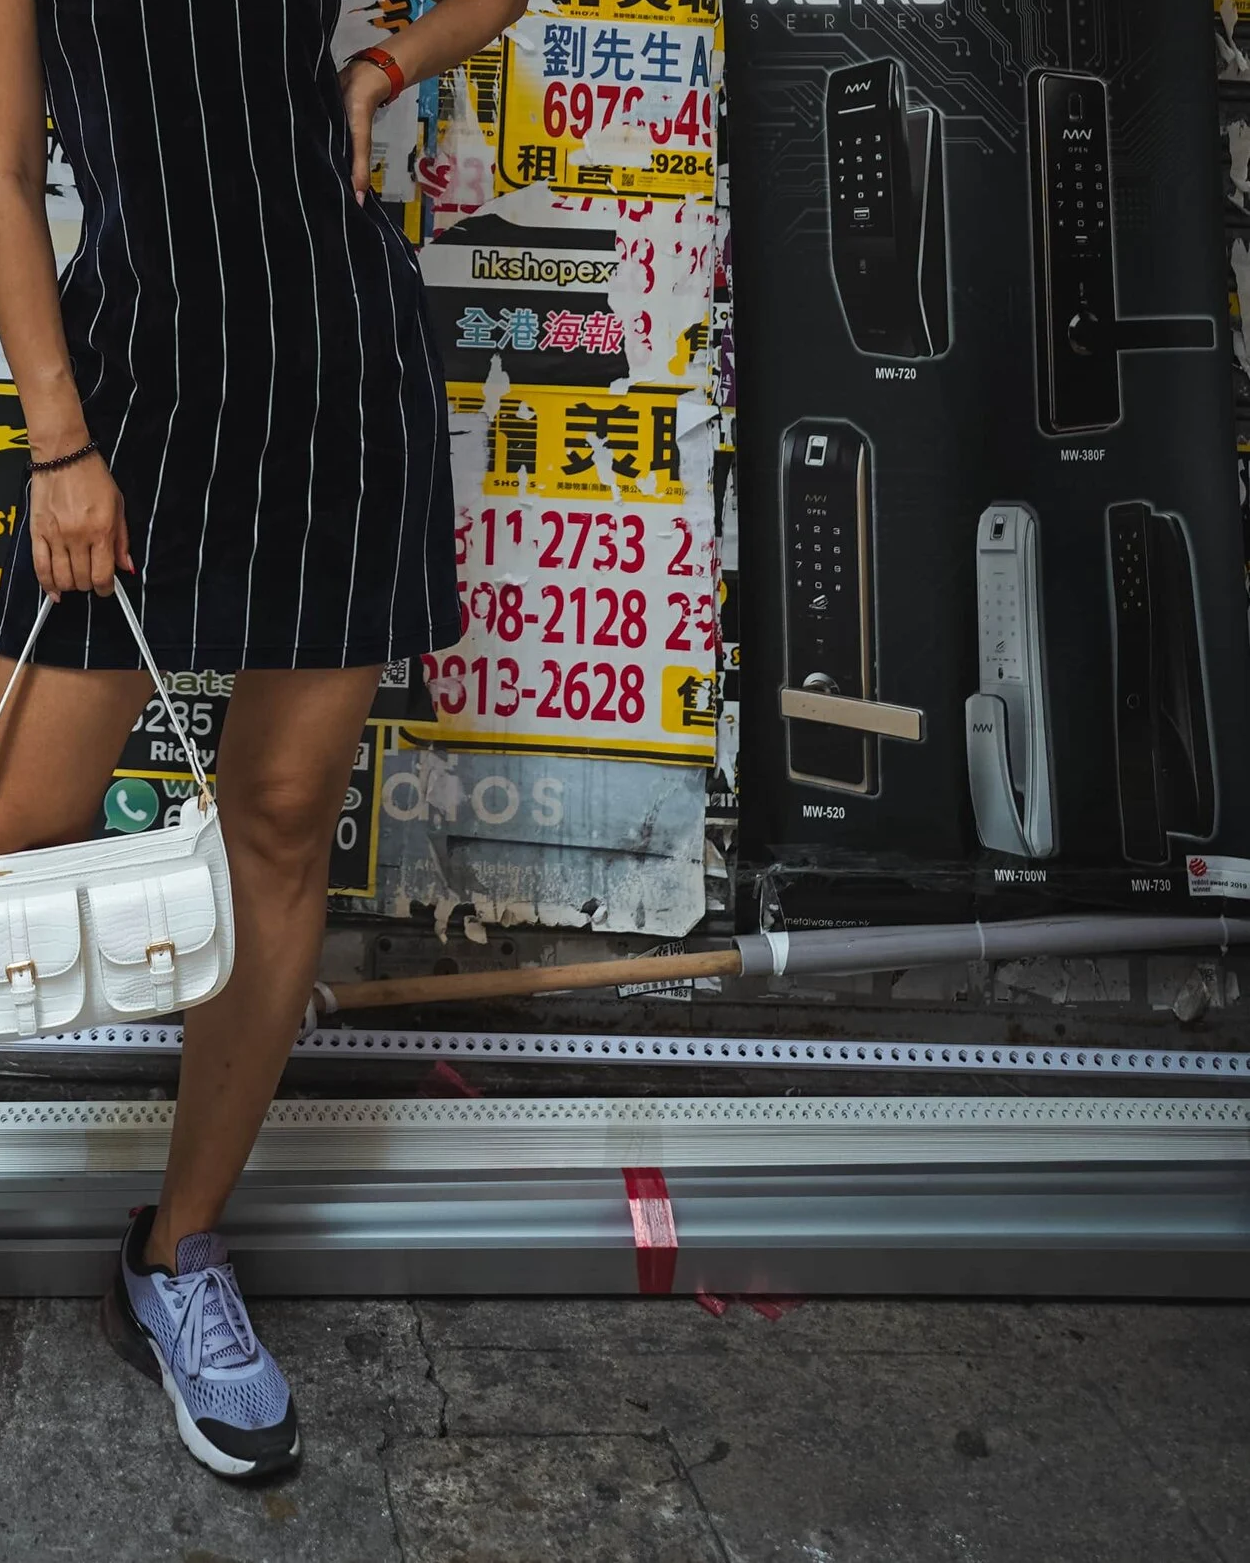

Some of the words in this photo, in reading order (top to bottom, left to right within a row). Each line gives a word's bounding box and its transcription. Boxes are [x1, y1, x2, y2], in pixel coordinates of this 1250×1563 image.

[516, 144, 557, 183] 租
[874, 366, 917, 381] MW-720
[1060, 448, 1106, 463] MW-380F
[802, 804, 846, 821] MW-520
[993, 867, 1047, 884] MW-700W
[1130, 878, 1172, 894] MW-730
